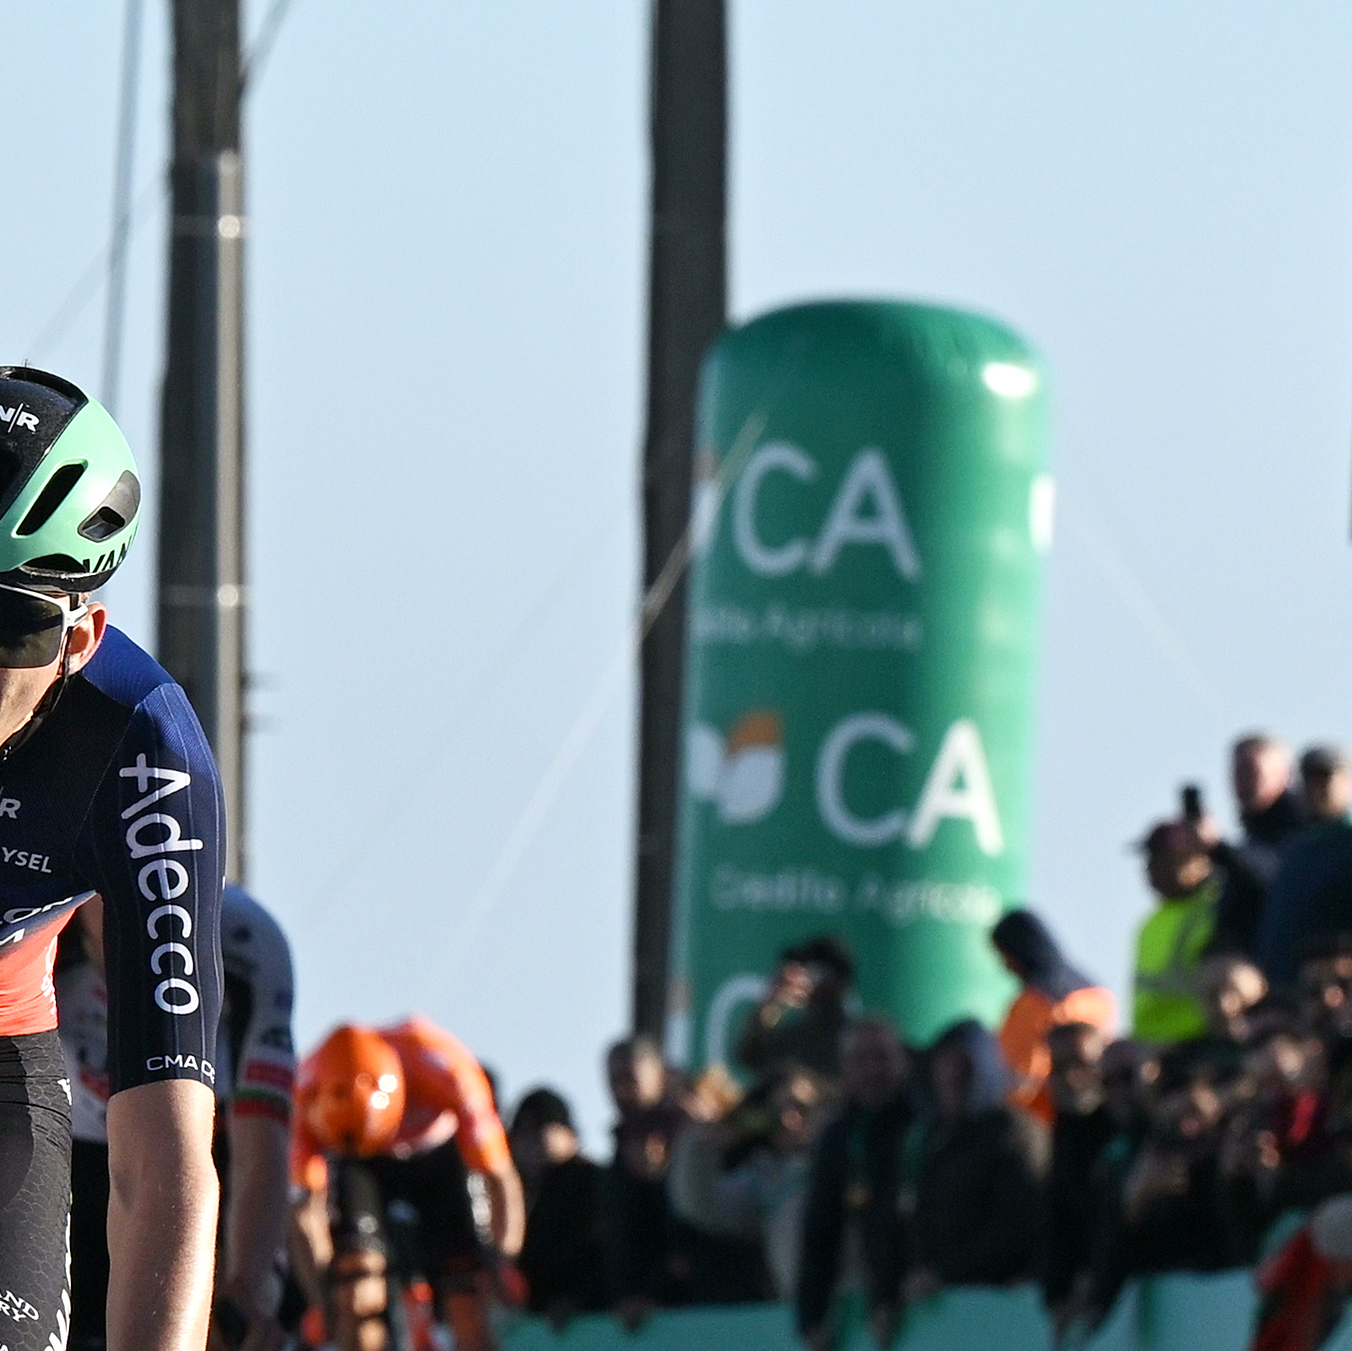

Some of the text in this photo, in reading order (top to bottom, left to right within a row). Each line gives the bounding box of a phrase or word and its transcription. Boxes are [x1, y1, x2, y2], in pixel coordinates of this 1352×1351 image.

[732, 440, 922, 582] CA
[816, 711, 1003, 855] CA
[118, 753, 204, 1014] Adecco
[146, 1055, 199, 1072] CMA
